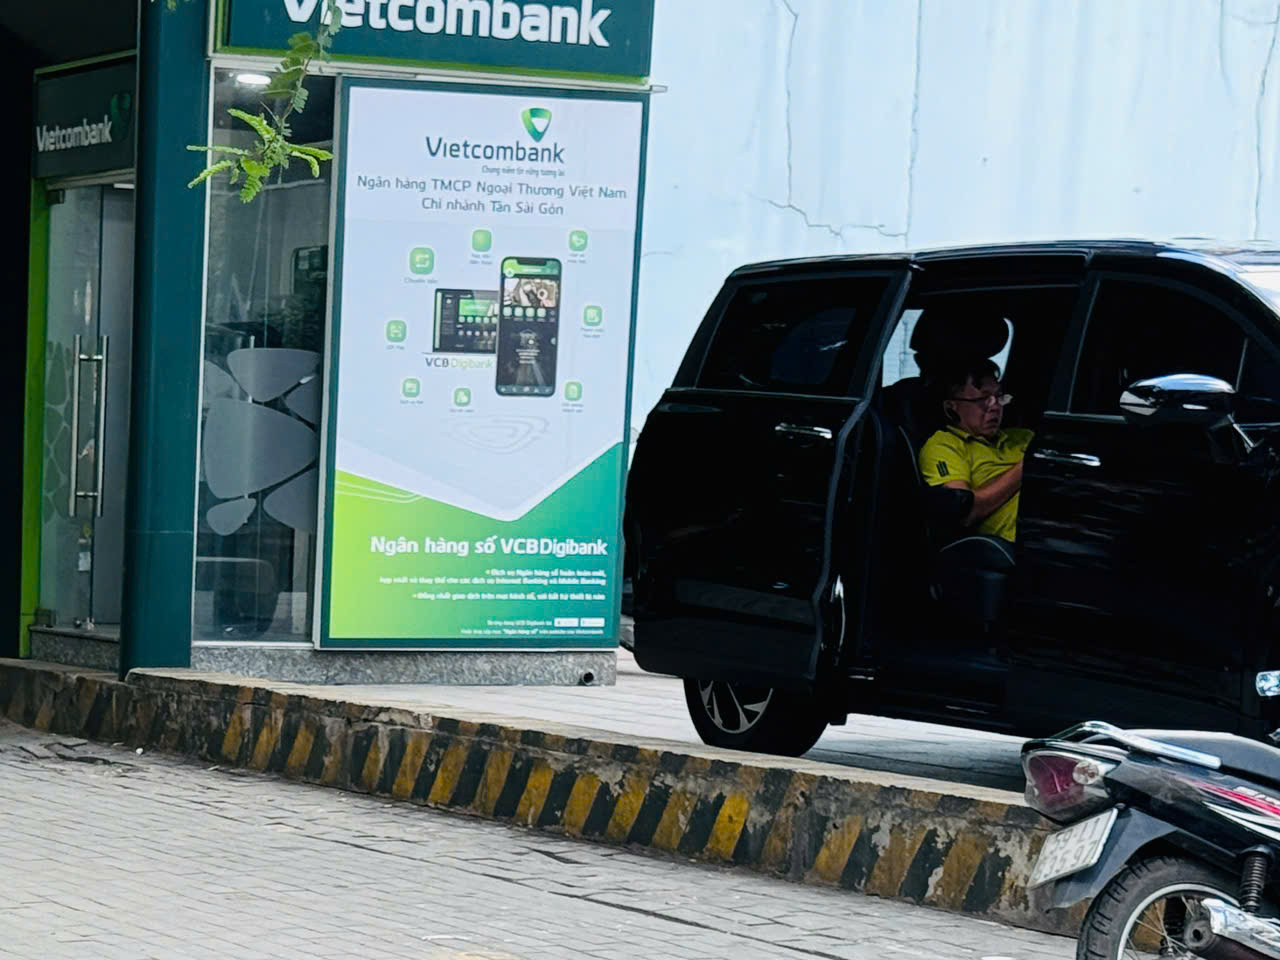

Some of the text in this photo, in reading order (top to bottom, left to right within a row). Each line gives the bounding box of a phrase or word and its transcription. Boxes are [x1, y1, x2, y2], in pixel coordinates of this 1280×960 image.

[36, 114, 112, 152] Vietcombank
[425, 136, 566, 164] Vietcombank
[357, 175, 391, 190] Ngân
[395, 177, 427, 192] hàng
[431, 178, 472, 192] TMCP
[569, 184, 595, 199] Việt
[598, 186, 627, 199] Nam
[370, 535, 419, 556] Ngân
[424, 536, 469, 557] hàng
[474, 534, 498, 554] số
